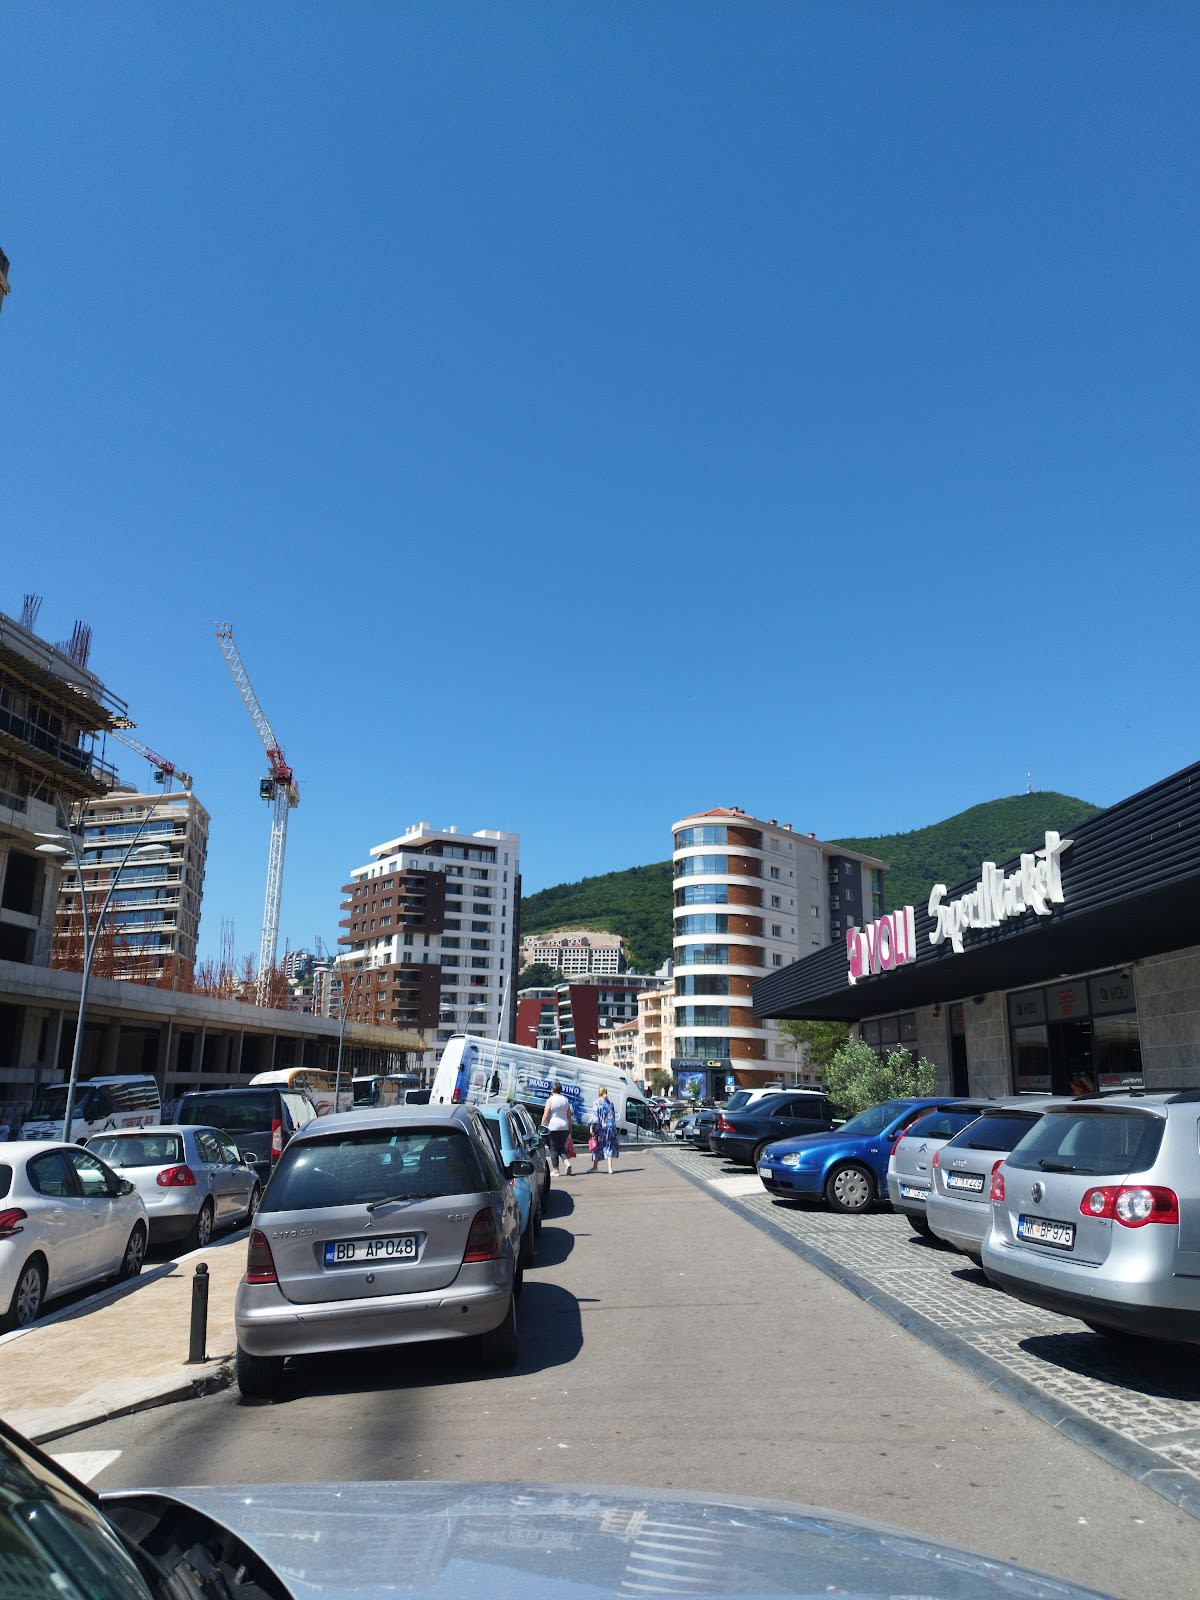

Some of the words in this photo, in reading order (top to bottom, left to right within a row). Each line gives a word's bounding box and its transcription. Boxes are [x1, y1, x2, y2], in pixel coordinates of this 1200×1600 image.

[866, 906, 916, 975] VOLI
[561, 1085, 580, 1095] VINO
[1024, 1216, 1036, 1233] NK
[1041, 1222, 1071, 1243] BP975
[337, 1244, 355, 1260] BD
[366, 1239, 413, 1257] AP048
